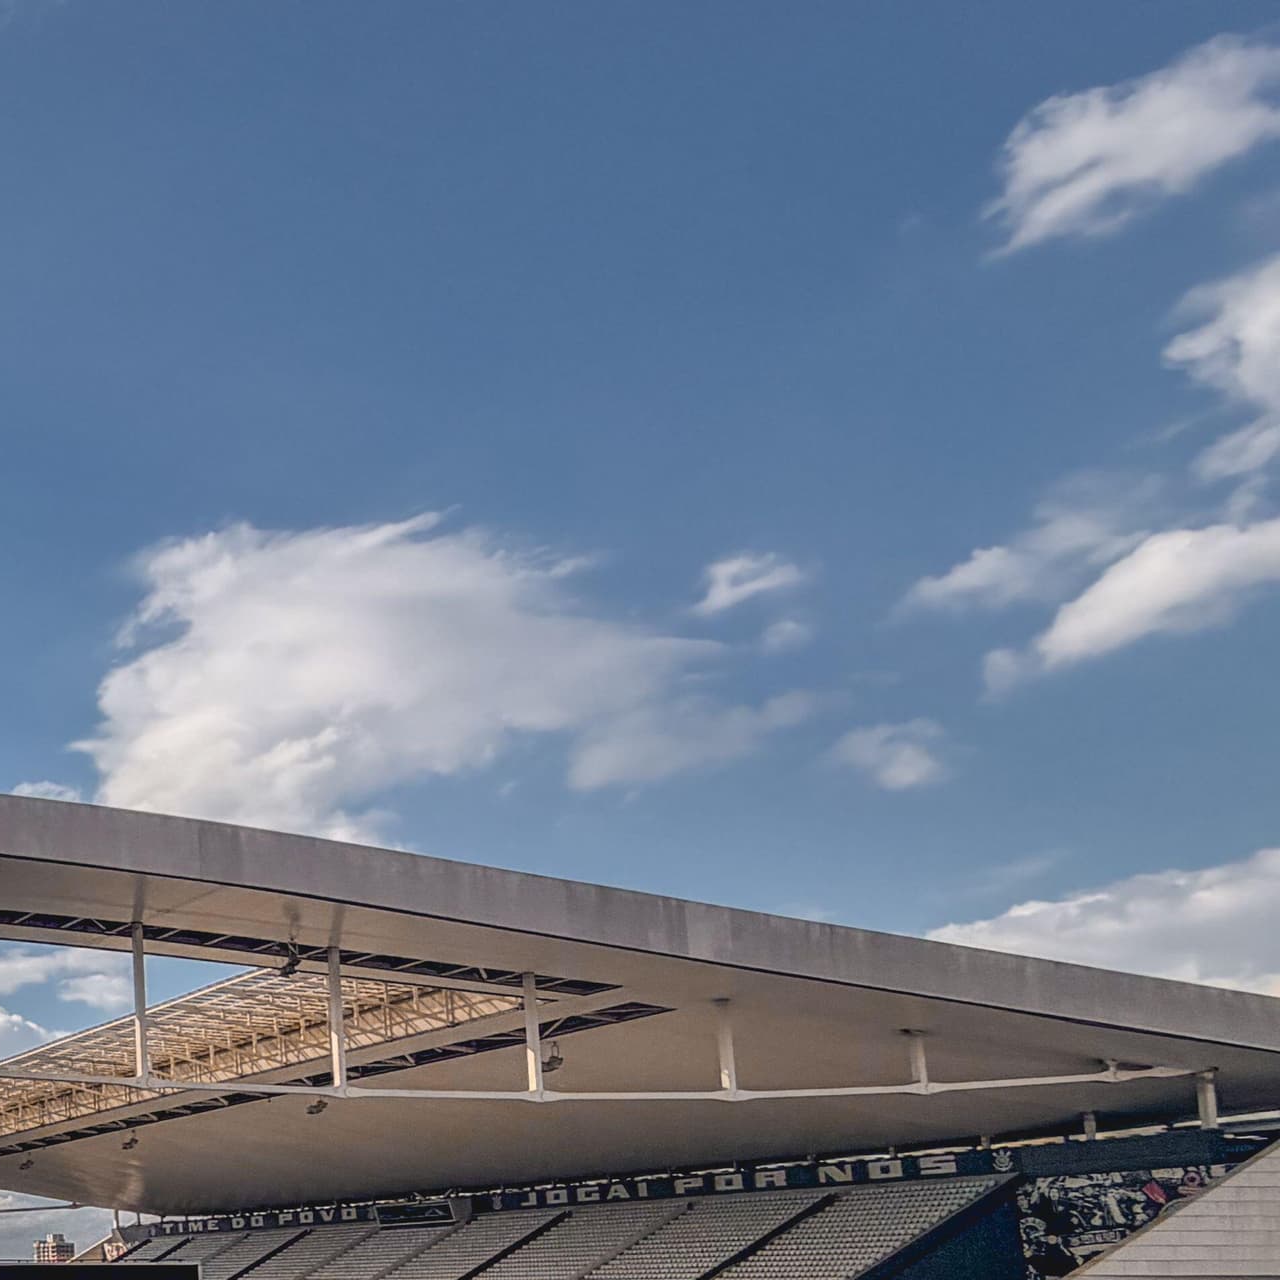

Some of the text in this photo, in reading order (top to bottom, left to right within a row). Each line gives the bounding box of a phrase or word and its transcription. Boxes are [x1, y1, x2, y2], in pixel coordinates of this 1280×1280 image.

[521, 1181, 648, 1207] JOGAI
[673, 1170, 787, 1194] POR
[162, 1207, 358, 1235] TIME DO POVO
